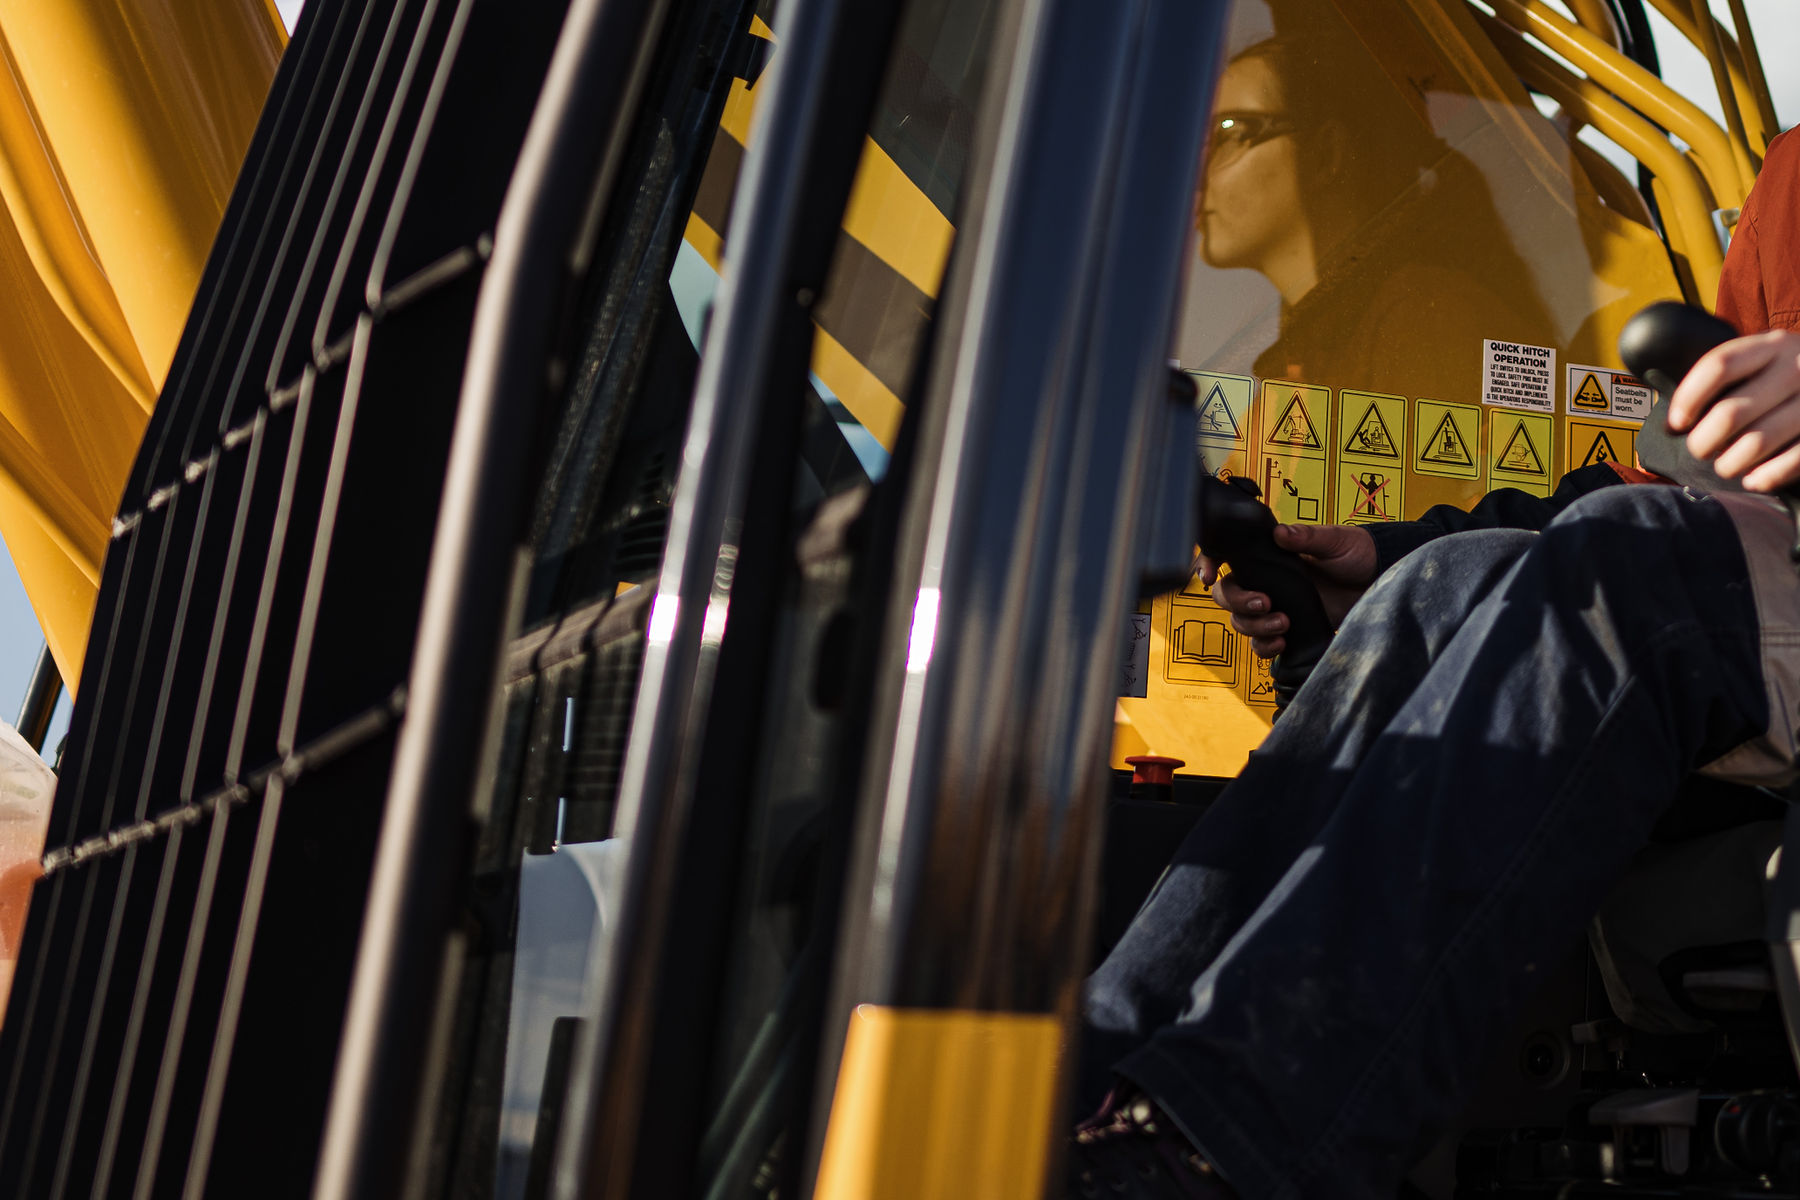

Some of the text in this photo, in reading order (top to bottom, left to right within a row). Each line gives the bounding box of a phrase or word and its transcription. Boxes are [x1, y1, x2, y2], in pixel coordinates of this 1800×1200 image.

[1491, 342, 1550, 357] QUICK HITCH
[1494, 354, 1546, 368] OPERATION
[1615, 387, 1647, 397] Seatbelts
